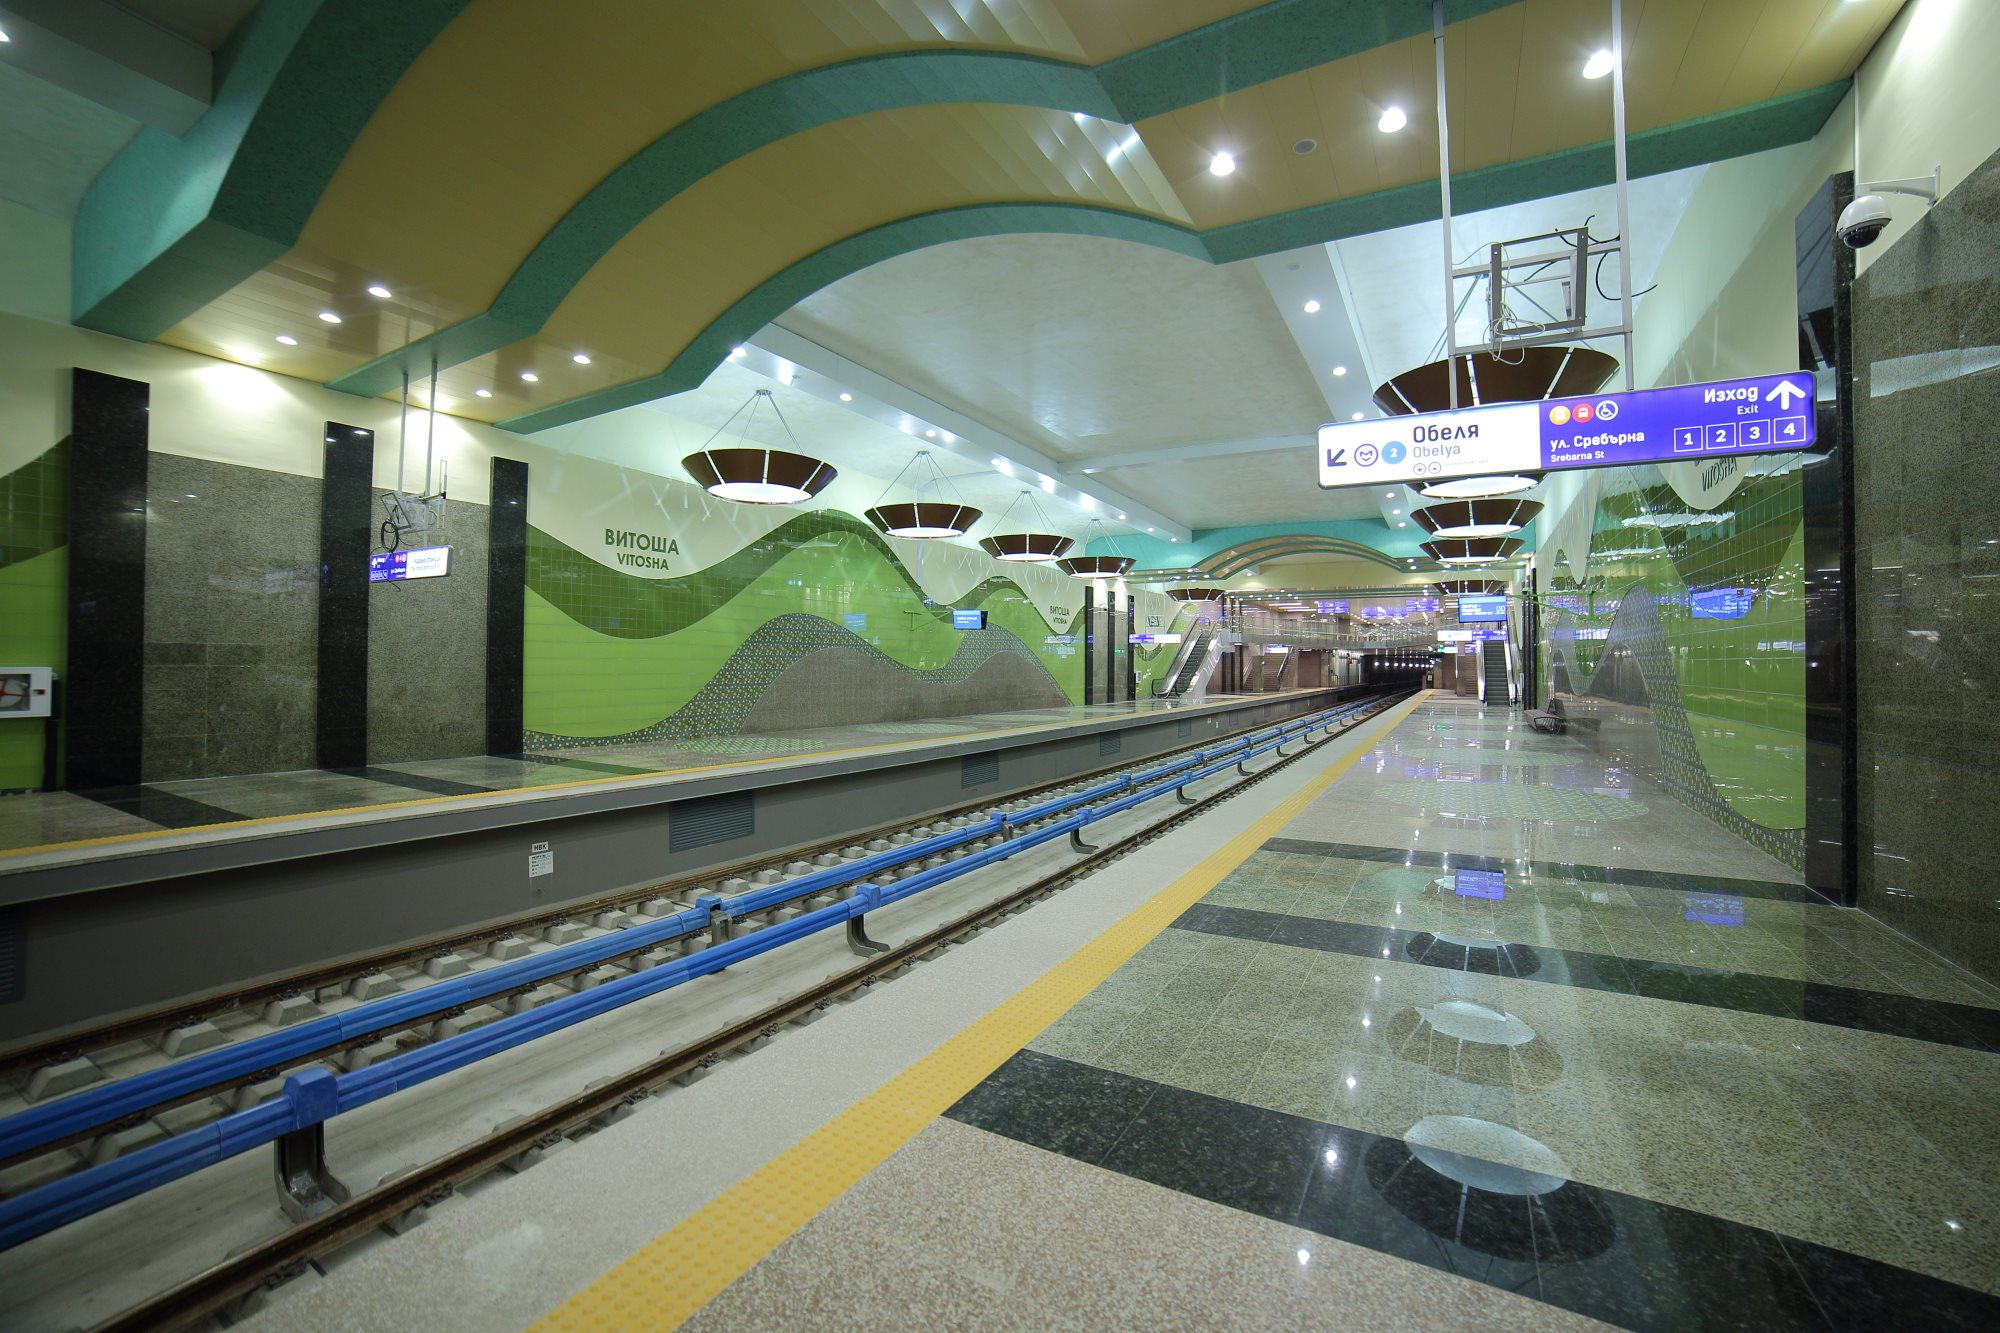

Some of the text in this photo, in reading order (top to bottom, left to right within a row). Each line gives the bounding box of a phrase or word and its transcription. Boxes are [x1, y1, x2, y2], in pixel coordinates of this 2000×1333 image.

[1704, 387, 1758, 403] Изход
[1737, 404, 1759, 415] Exit
[1413, 425, 1479, 443] Обеля
[1550, 432, 1645, 452] ул. Сребърна
[1684, 423, 1795, 445] 1 2 3 4
[1390, 448, 1398, 458] 2
[1413, 444, 1461, 458] Obelya
[1550, 450, 1604, 462] Srebarna St
[1702, 457, 1737, 491] VITOSHA
[604, 528, 680, 555] ВИТОША
[616, 553, 670, 570] VITOSHA
